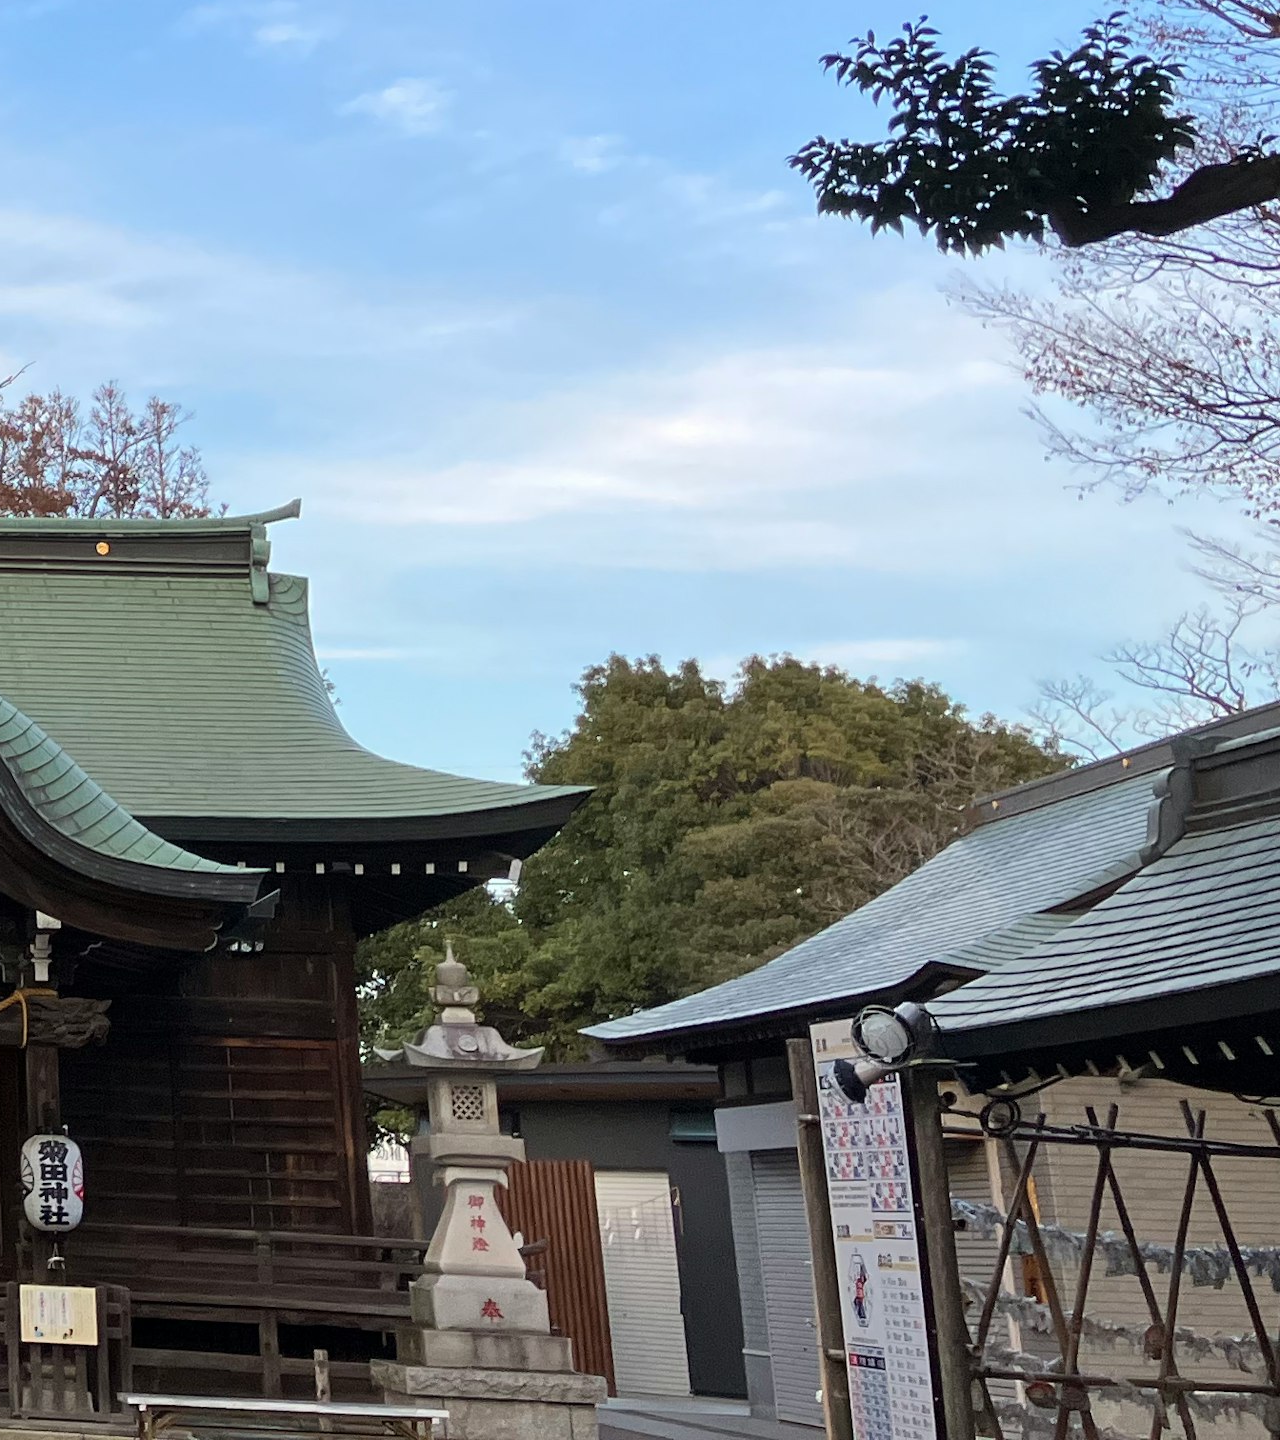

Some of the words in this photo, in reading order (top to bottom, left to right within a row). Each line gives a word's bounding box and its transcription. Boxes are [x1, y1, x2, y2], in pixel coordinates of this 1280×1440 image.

[38, 1140, 70, 1226] 菊田神社
[480, 1298, 505, 1323] 奉
